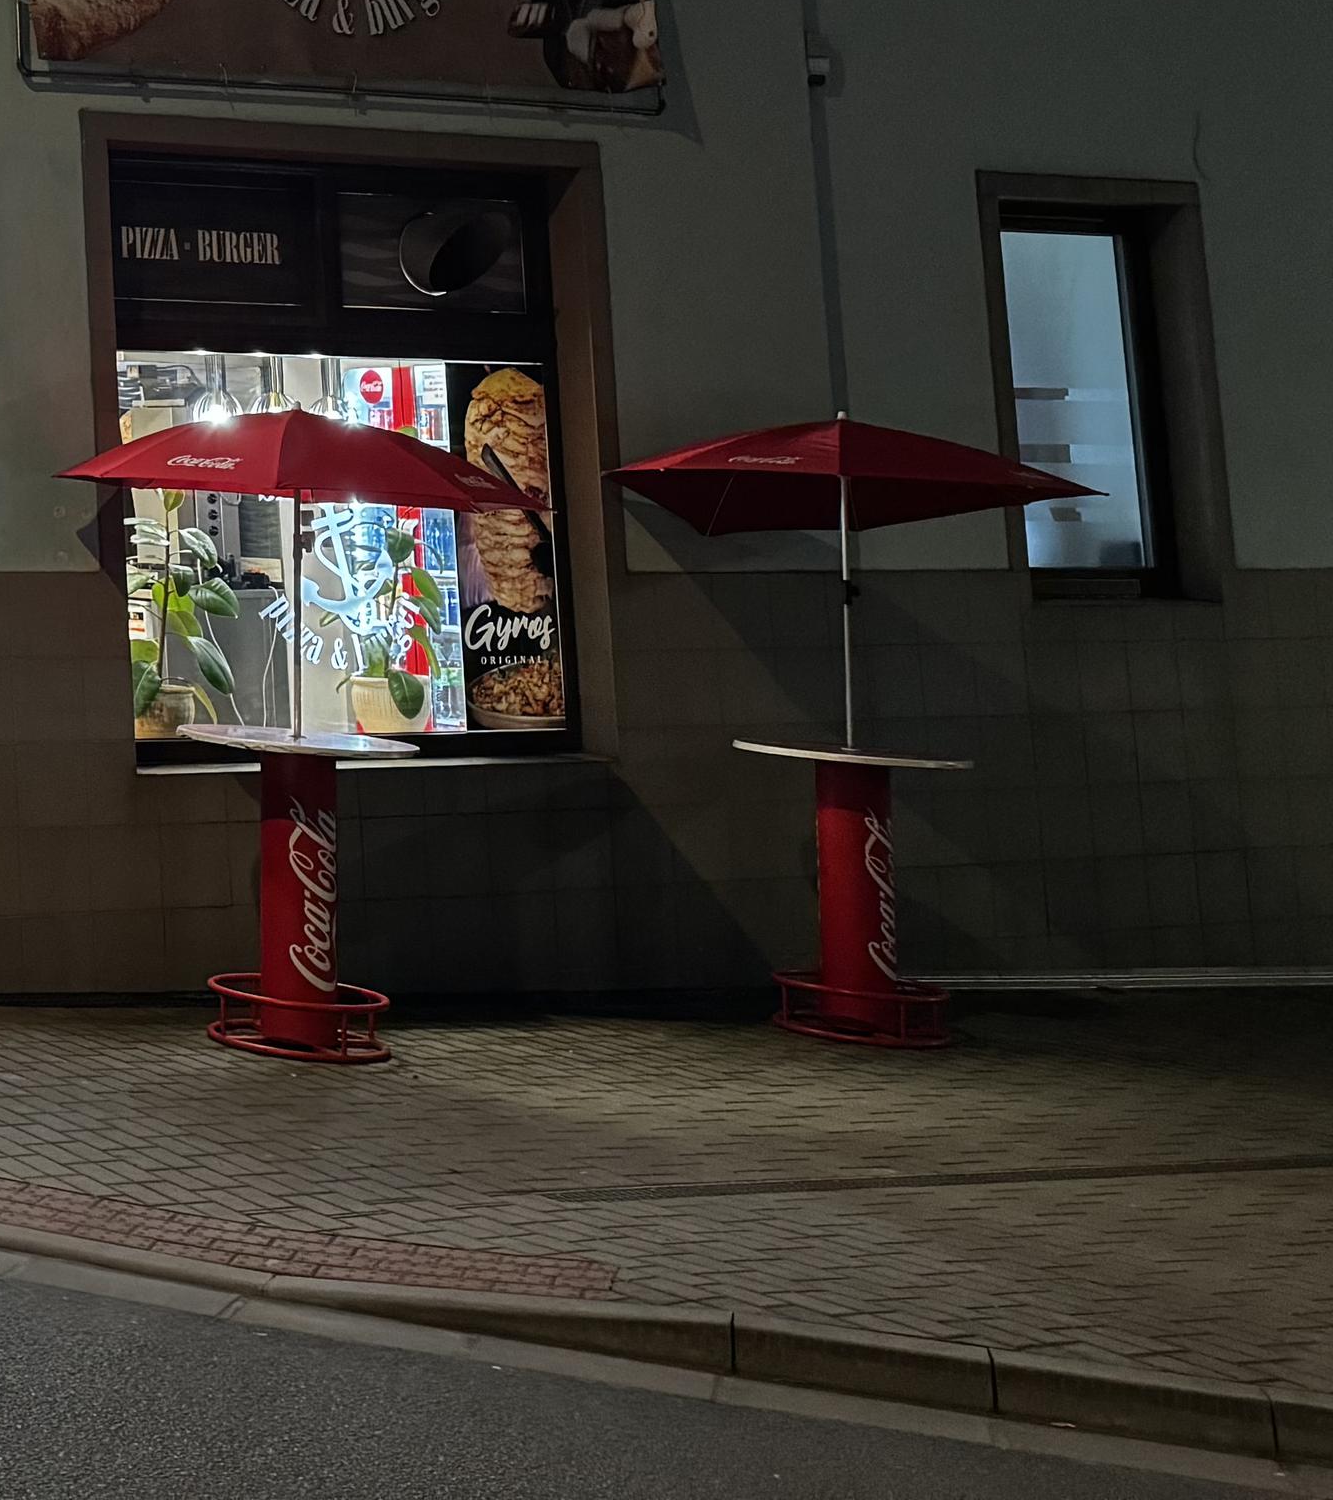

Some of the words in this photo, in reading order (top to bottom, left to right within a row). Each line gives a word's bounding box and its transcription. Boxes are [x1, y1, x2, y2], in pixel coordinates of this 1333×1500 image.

[121, 226, 180, 261] PIZZA
[197, 229, 282, 265] BURGER
[464, 603, 556, 652] Gyros
[331, 637, 350, 671] &
[480, 654, 544, 666] ORIGINAL
